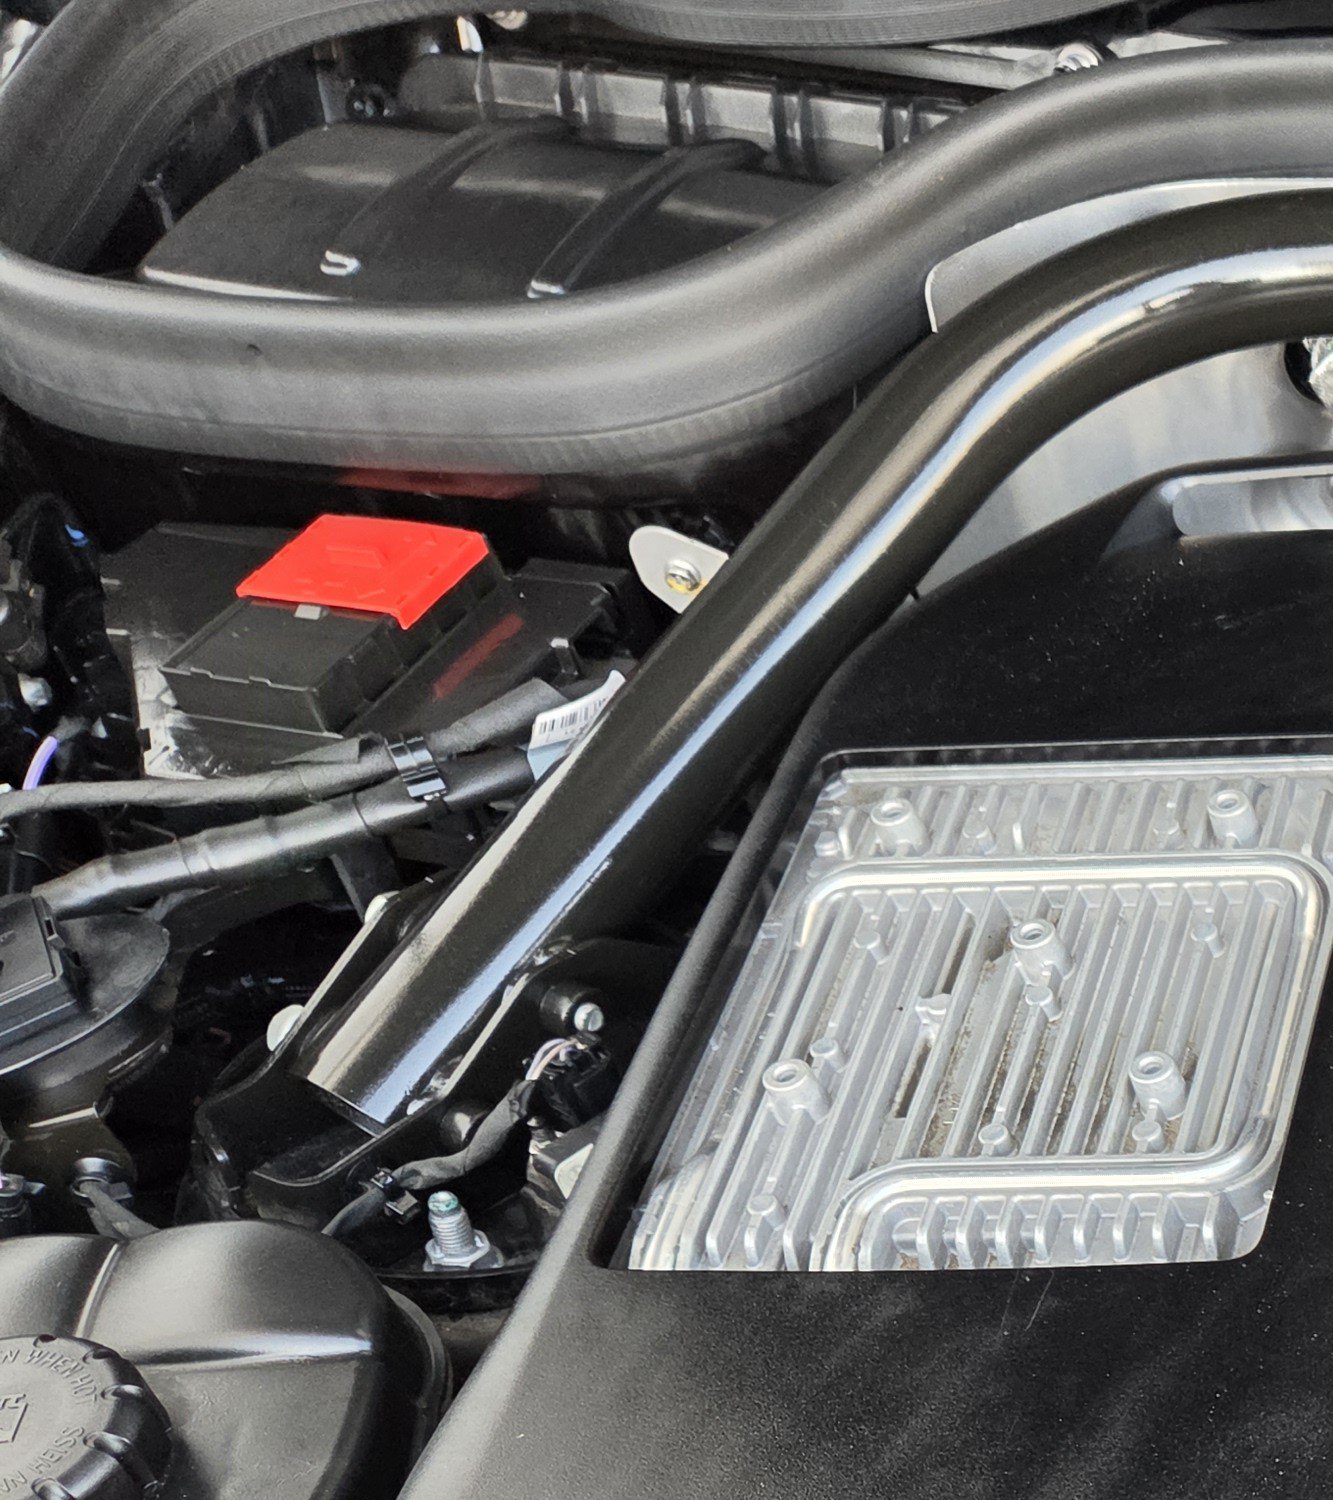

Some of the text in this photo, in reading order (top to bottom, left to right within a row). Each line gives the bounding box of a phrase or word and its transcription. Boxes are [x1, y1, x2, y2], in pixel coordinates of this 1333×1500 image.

[25, 1349, 84, 1379] WHEN
[70, 1373, 99, 1405] HOT
[28, 1426, 86, 1475] HEISS
